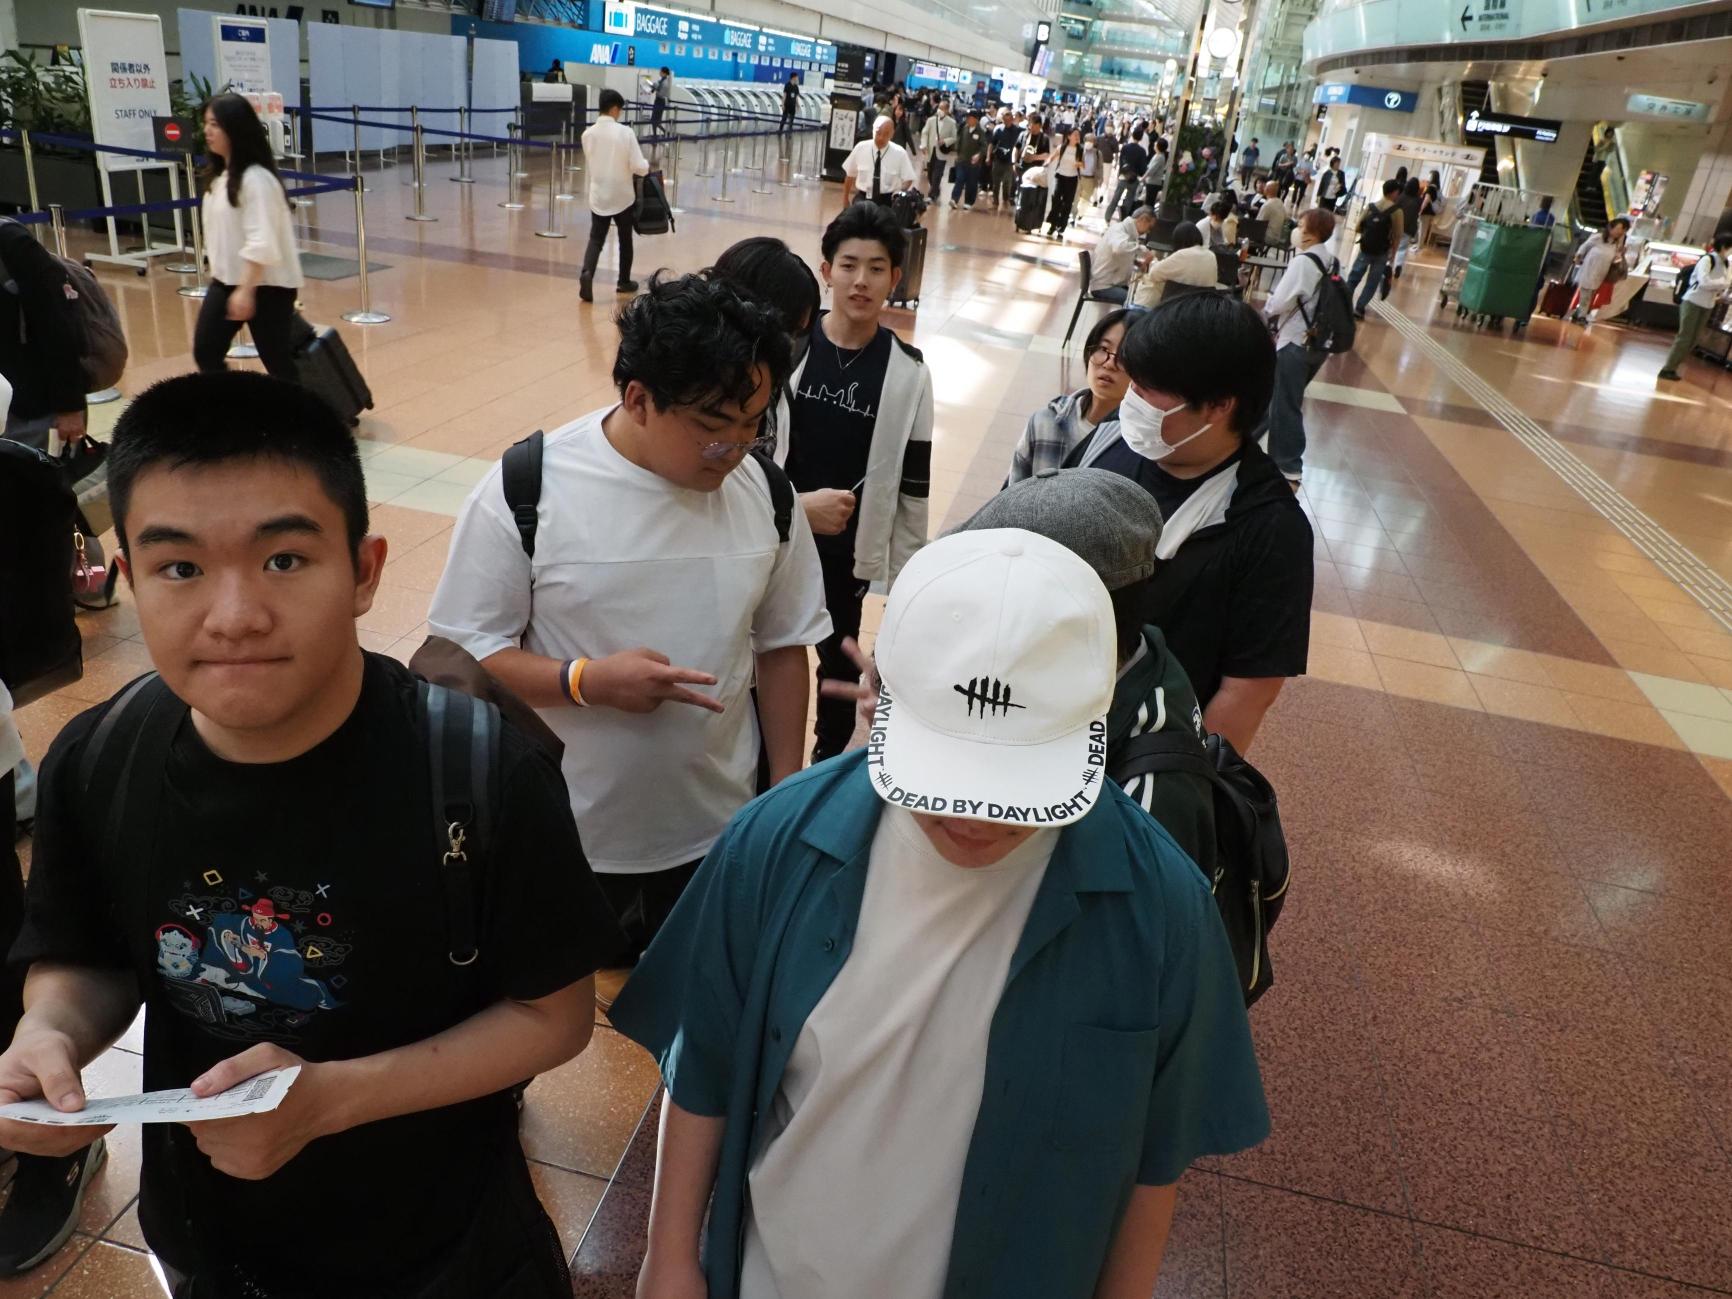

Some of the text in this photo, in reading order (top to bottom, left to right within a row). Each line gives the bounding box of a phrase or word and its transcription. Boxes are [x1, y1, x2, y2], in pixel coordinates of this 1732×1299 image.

[636, 13, 668, 35] BAGGAGE
[730, 30, 752, 48] BAGGAGE
[589, 43, 610, 64] ANA
[111, 62, 151, 74] 関係者以外
[109, 77, 156, 89] 立ち入り禁止
[114, 109, 137, 119] STAFF
[1087, 720, 1105, 767] DEAD
[887, 786, 1091, 823] DEAD BY DAYLIGHT
